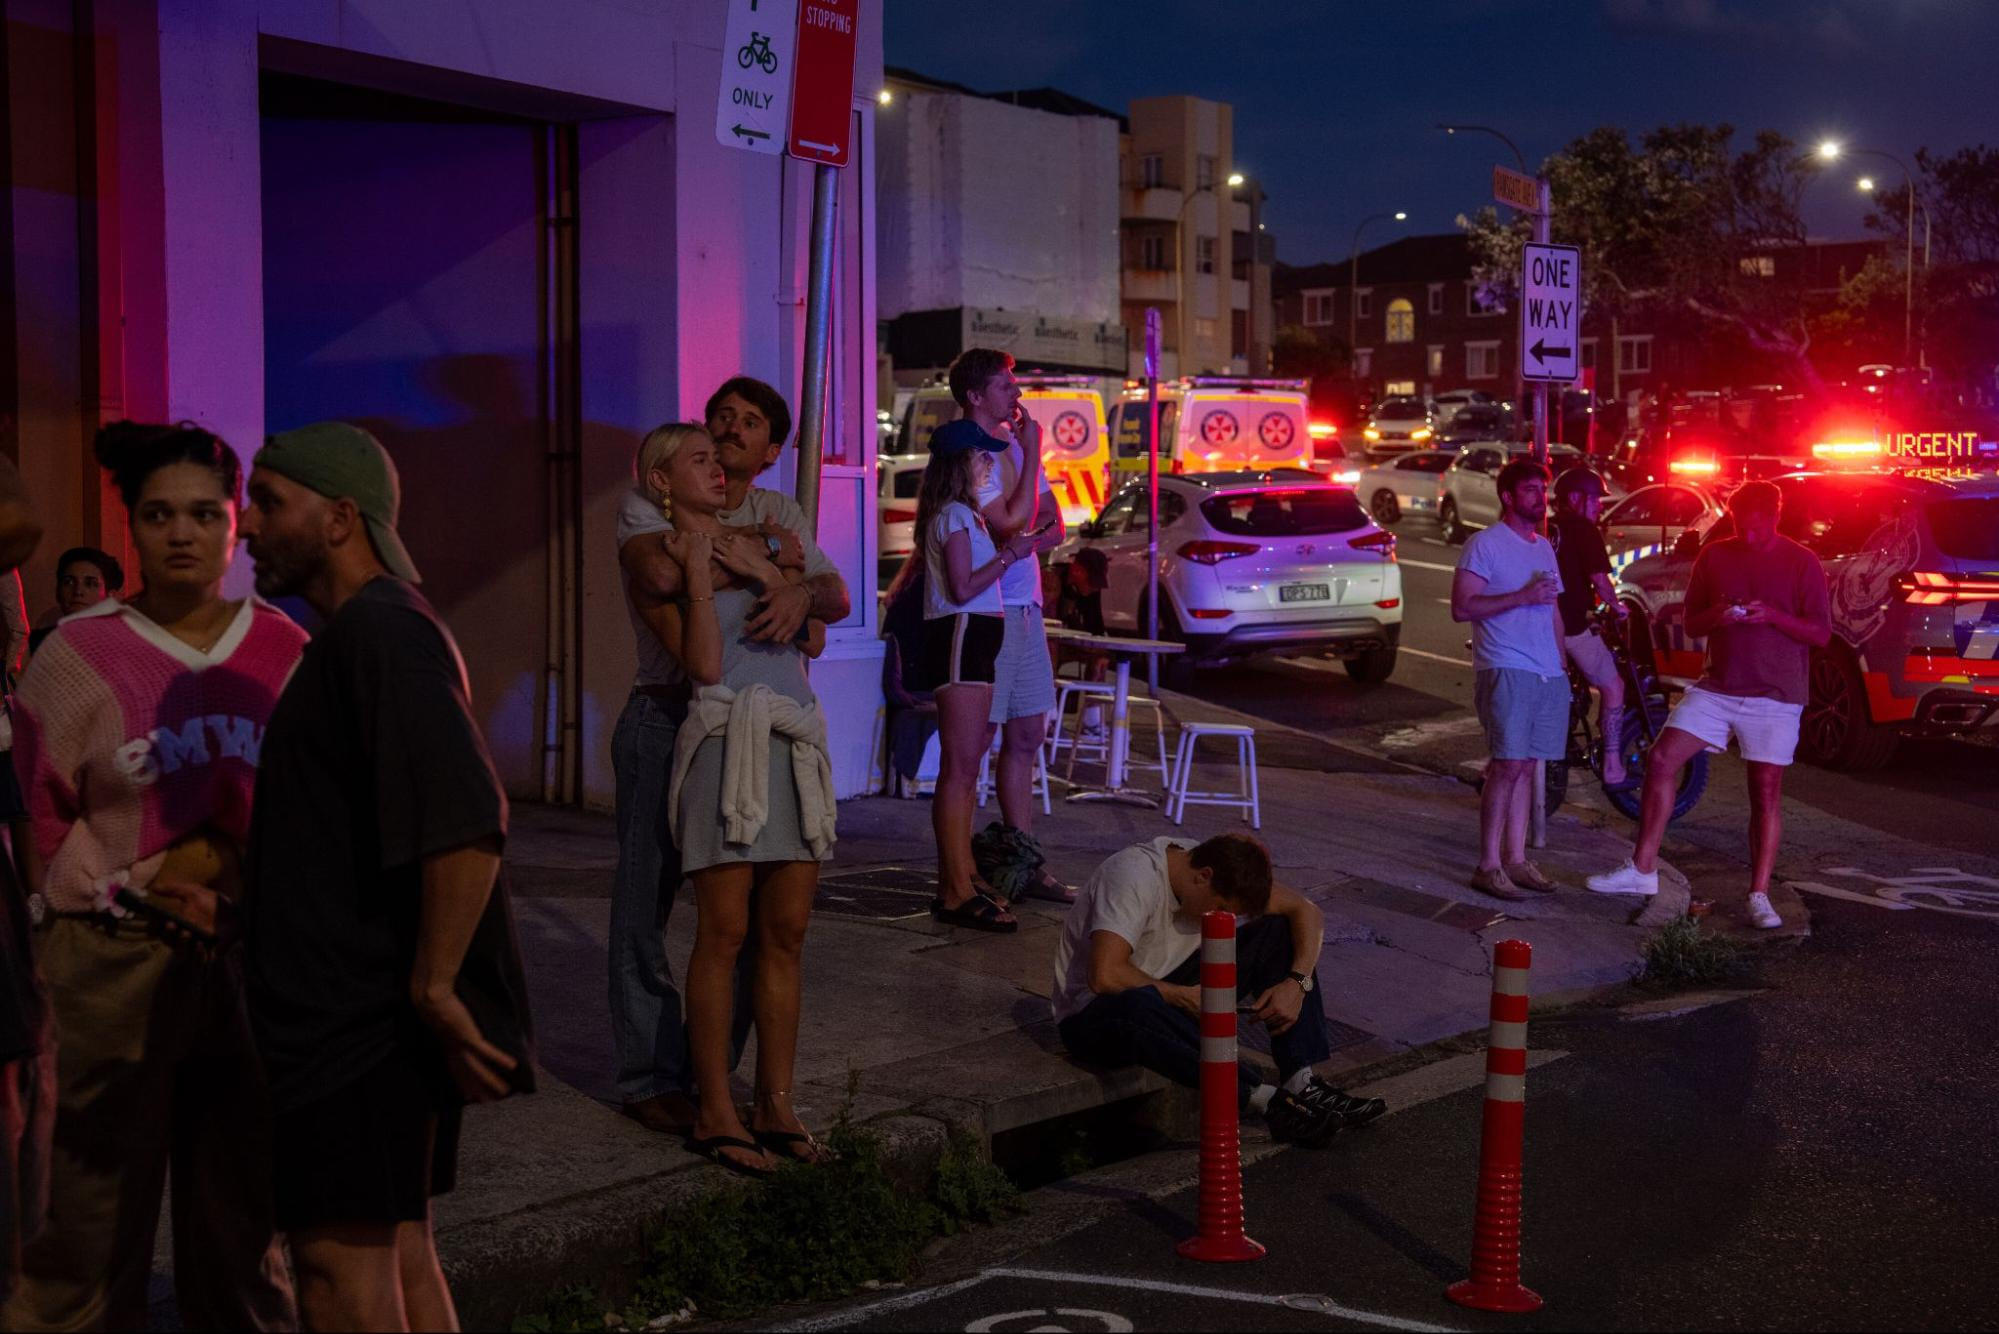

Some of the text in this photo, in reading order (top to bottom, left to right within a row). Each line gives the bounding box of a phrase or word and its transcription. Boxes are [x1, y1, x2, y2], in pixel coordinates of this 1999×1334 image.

[806, 6, 851, 34] STOPPING
[733, 88, 773, 110] ONLY
[1532, 257, 1570, 288] ONE
[1529, 298, 1572, 329] WAY
[1887, 433, 1978, 456] URGENT
